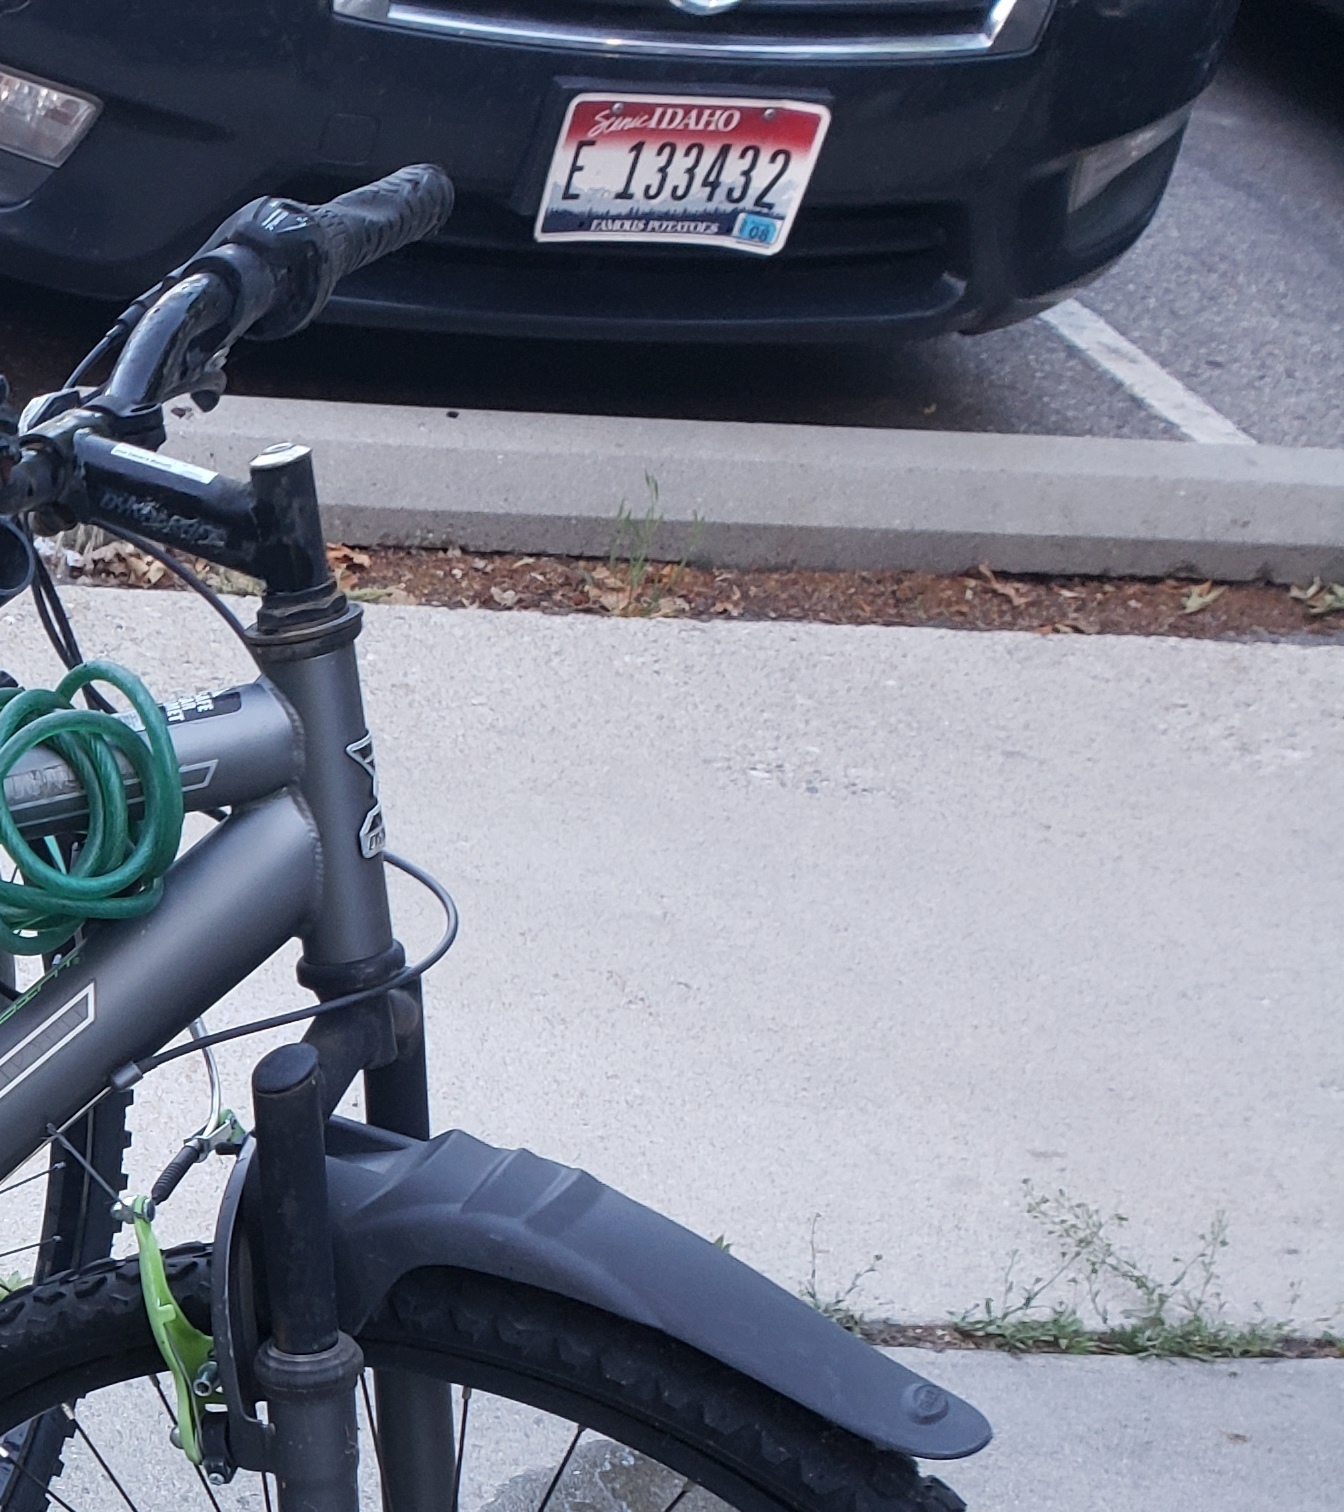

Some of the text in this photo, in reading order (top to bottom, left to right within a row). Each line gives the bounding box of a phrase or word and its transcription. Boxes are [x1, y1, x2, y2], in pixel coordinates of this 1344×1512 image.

[648, 107, 741, 132] IDAHO
[562, 140, 791, 209] E 133432
[590, 219, 720, 235] FAMOUS POTATOES
